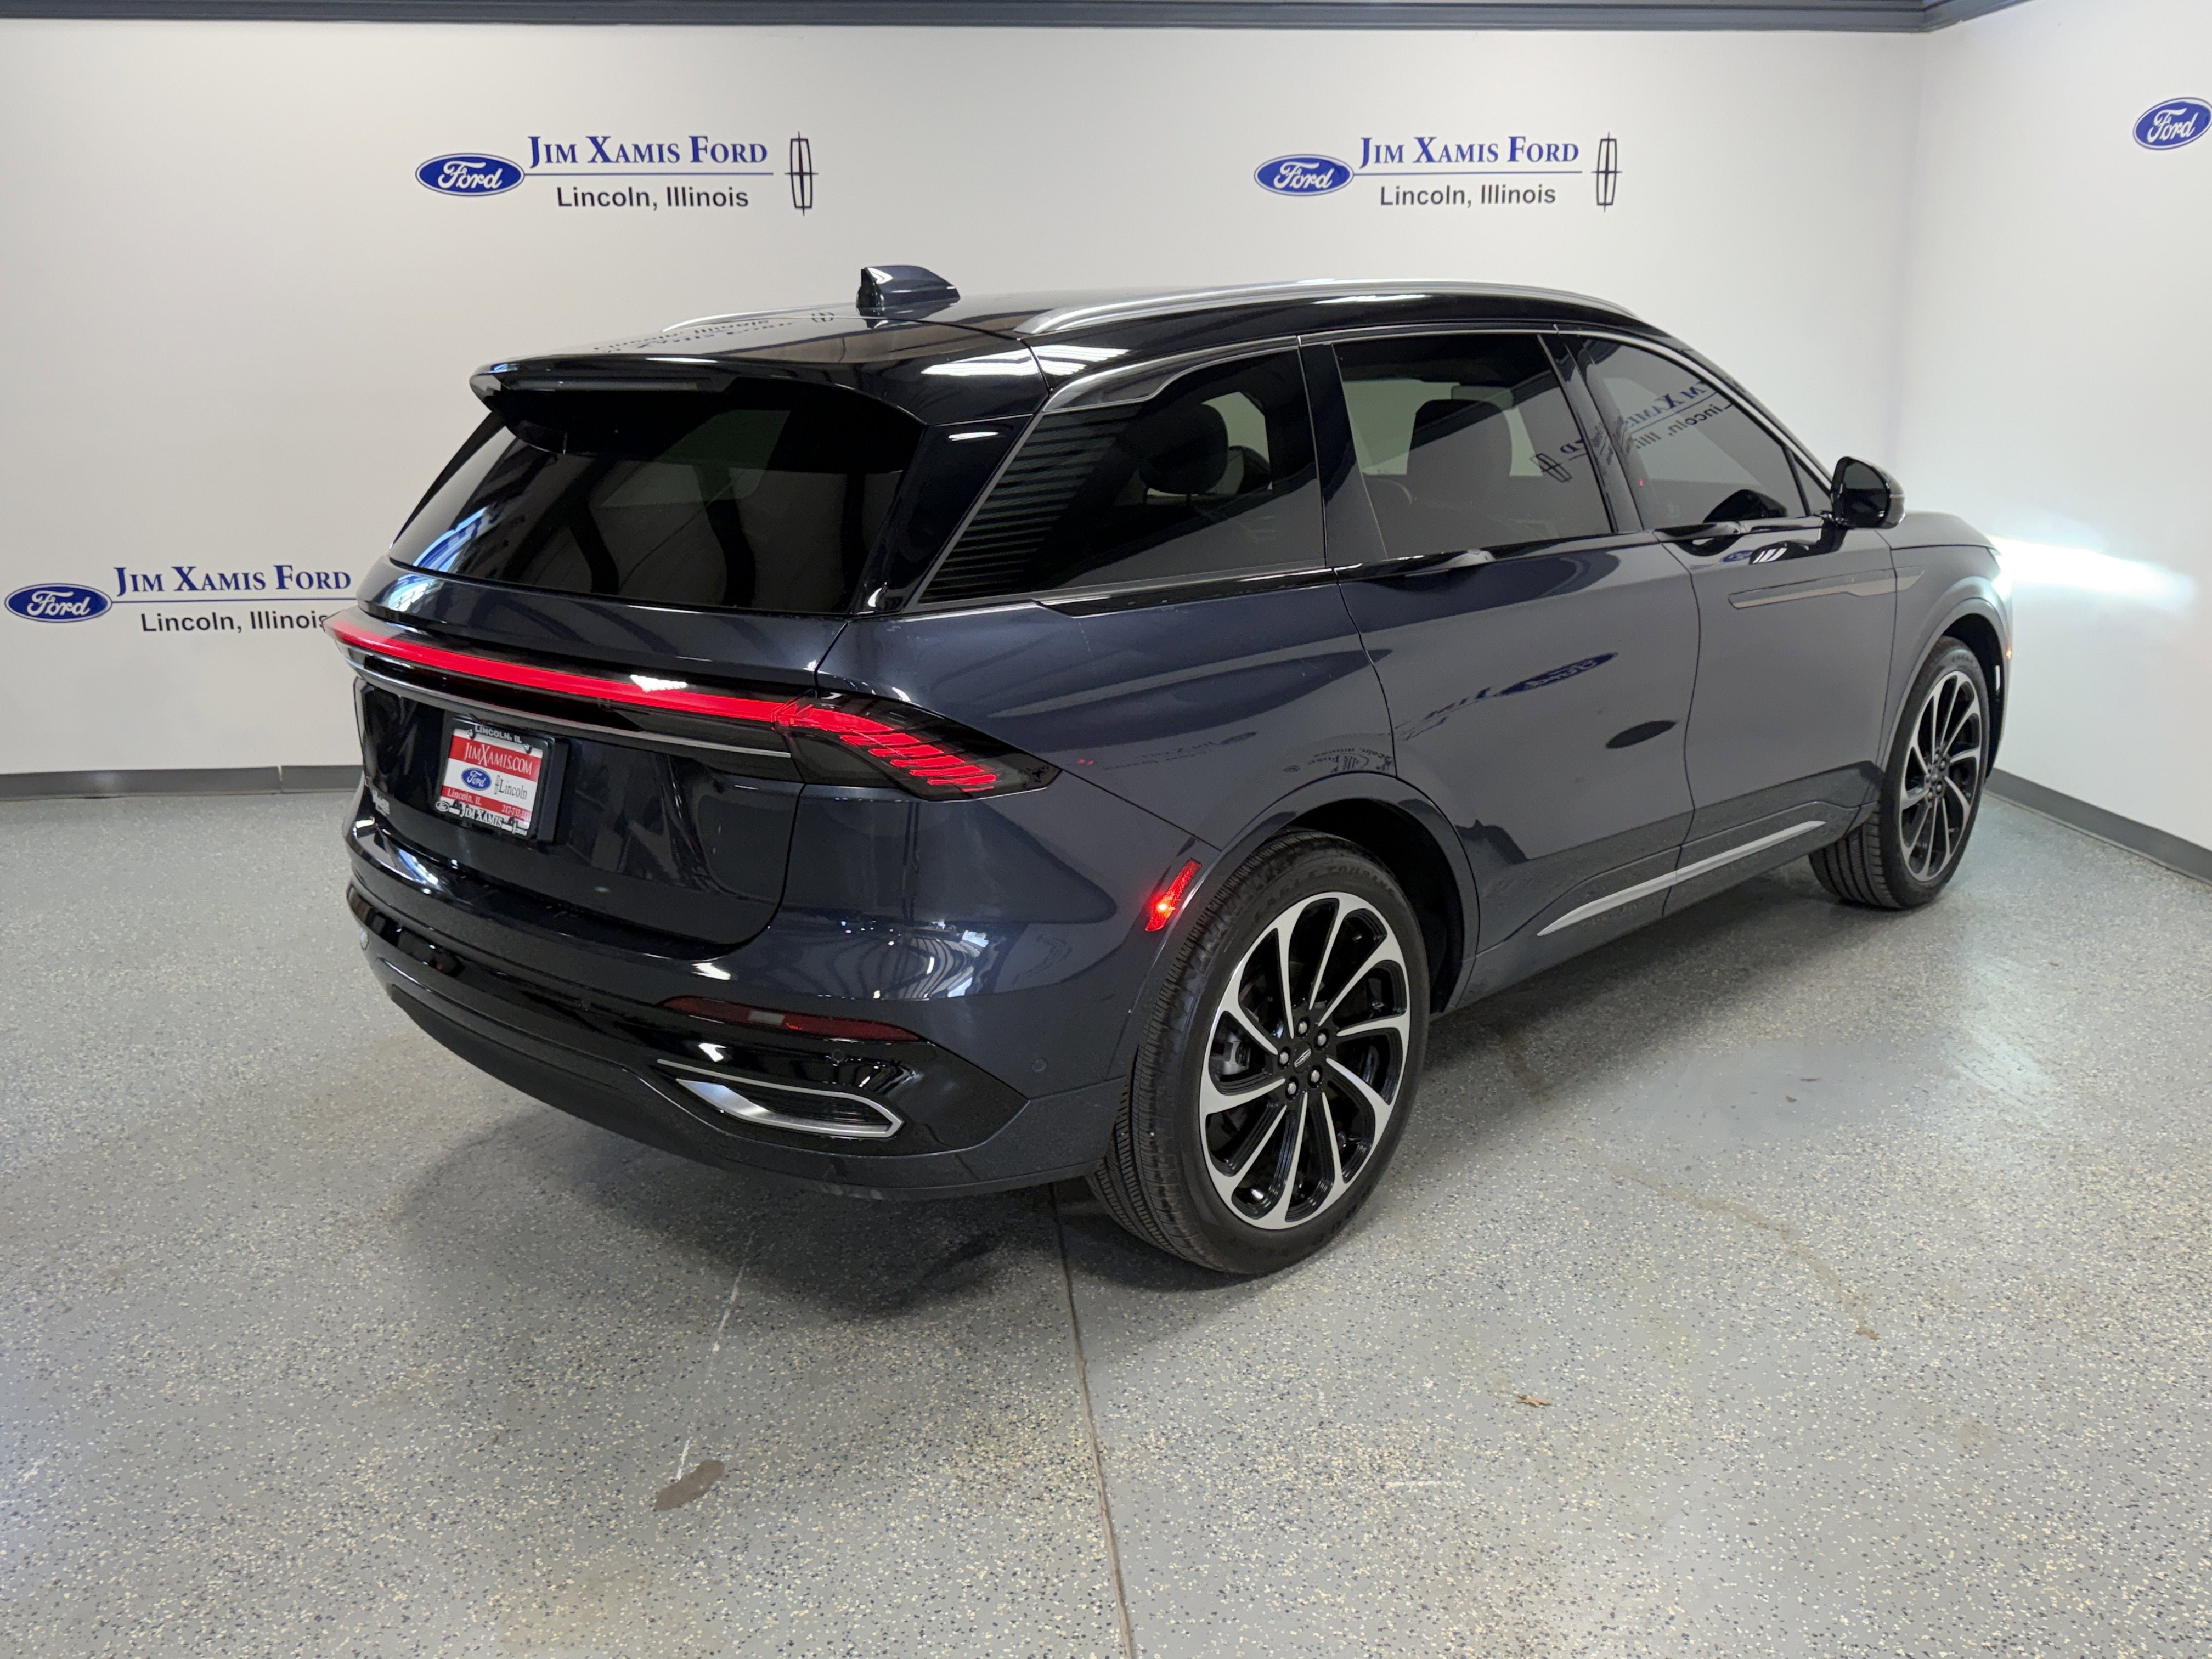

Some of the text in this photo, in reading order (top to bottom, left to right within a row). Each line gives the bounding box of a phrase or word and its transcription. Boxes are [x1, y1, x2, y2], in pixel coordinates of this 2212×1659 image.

[2147, 108, 2199, 143] Ford
[528, 136, 768, 169] JIM XAMIS FORD
[1359, 136, 1578, 170] JIM XAMIS FORD
[438, 161, 503, 190] Ford
[1274, 162, 1333, 190] Ford
[557, 187, 749, 211] Lincoln, Illinois
[1380, 184, 1556, 208] Lincoln, Illinois
[114, 565, 351, 597] JIM XAMIS FORD
[27, 590, 90, 617] Ford
[140, 612, 242, 633] Lincoln,
[514, 735, 523, 743] IL
[467, 770, 485, 787] Ford
[499, 778, 527, 800] Lincoln
[460, 803, 476, 819] JIM
[476, 809, 503, 828] XAMIS
